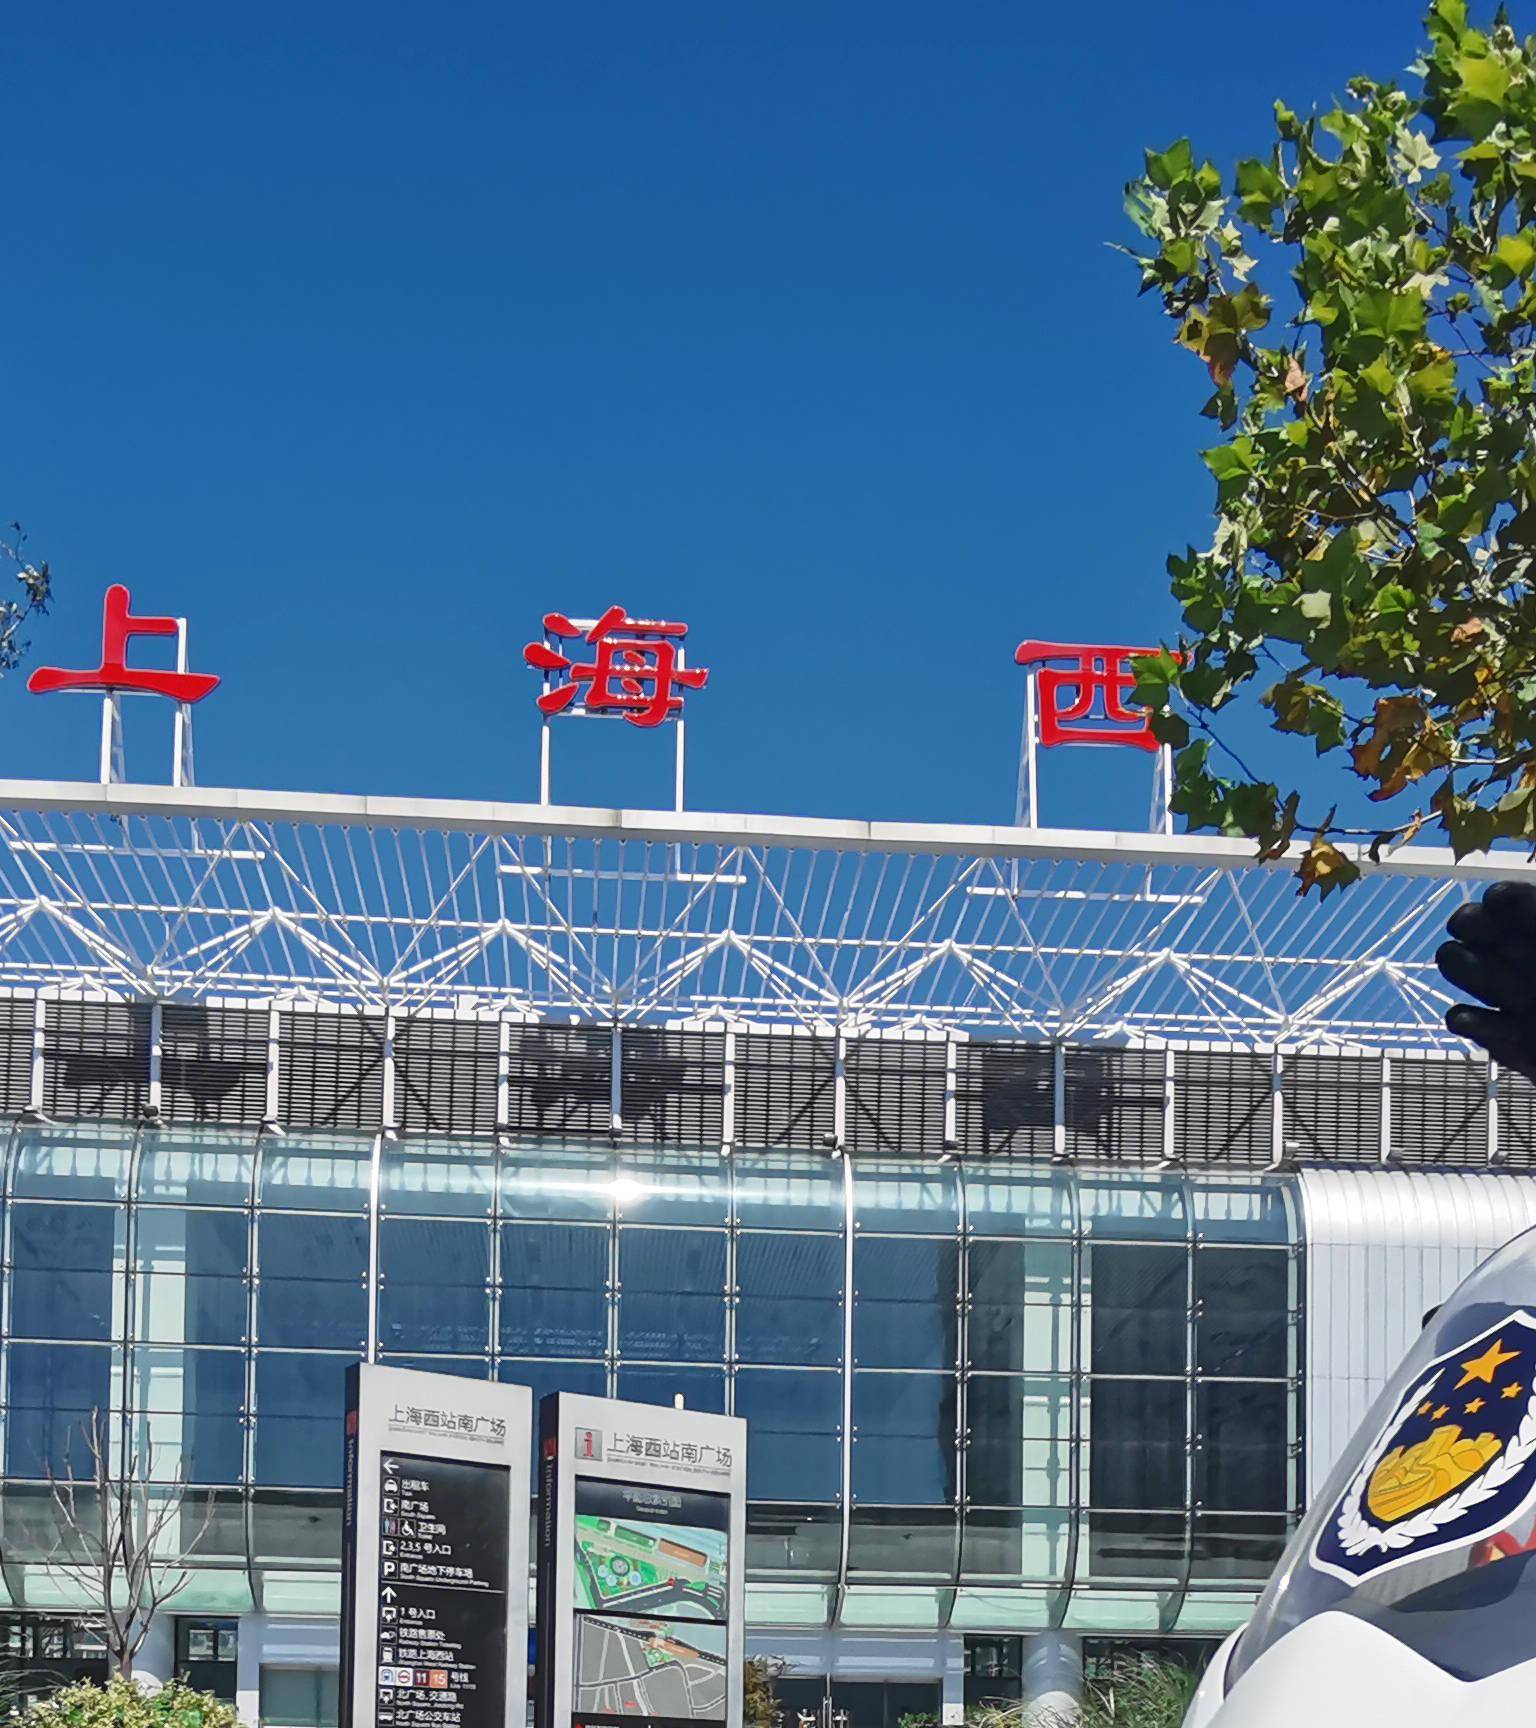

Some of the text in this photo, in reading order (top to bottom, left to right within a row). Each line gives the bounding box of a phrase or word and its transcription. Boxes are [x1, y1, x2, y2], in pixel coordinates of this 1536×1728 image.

[27, 584, 1194, 752] 上海西
[388, 1404, 506, 1438] 上海西站南广场
[607, 1432, 732, 1467] 上海西站南广场
[544, 1461, 553, 1547] Information
[424, 1542, 452, 1555] 号入口
[408, 1607, 436, 1620] 号入口
[416, 1672, 427, 1684] 11
[433, 1673, 445, 1685] 15
[396, 1709, 462, 1722] 北广场公交车站
